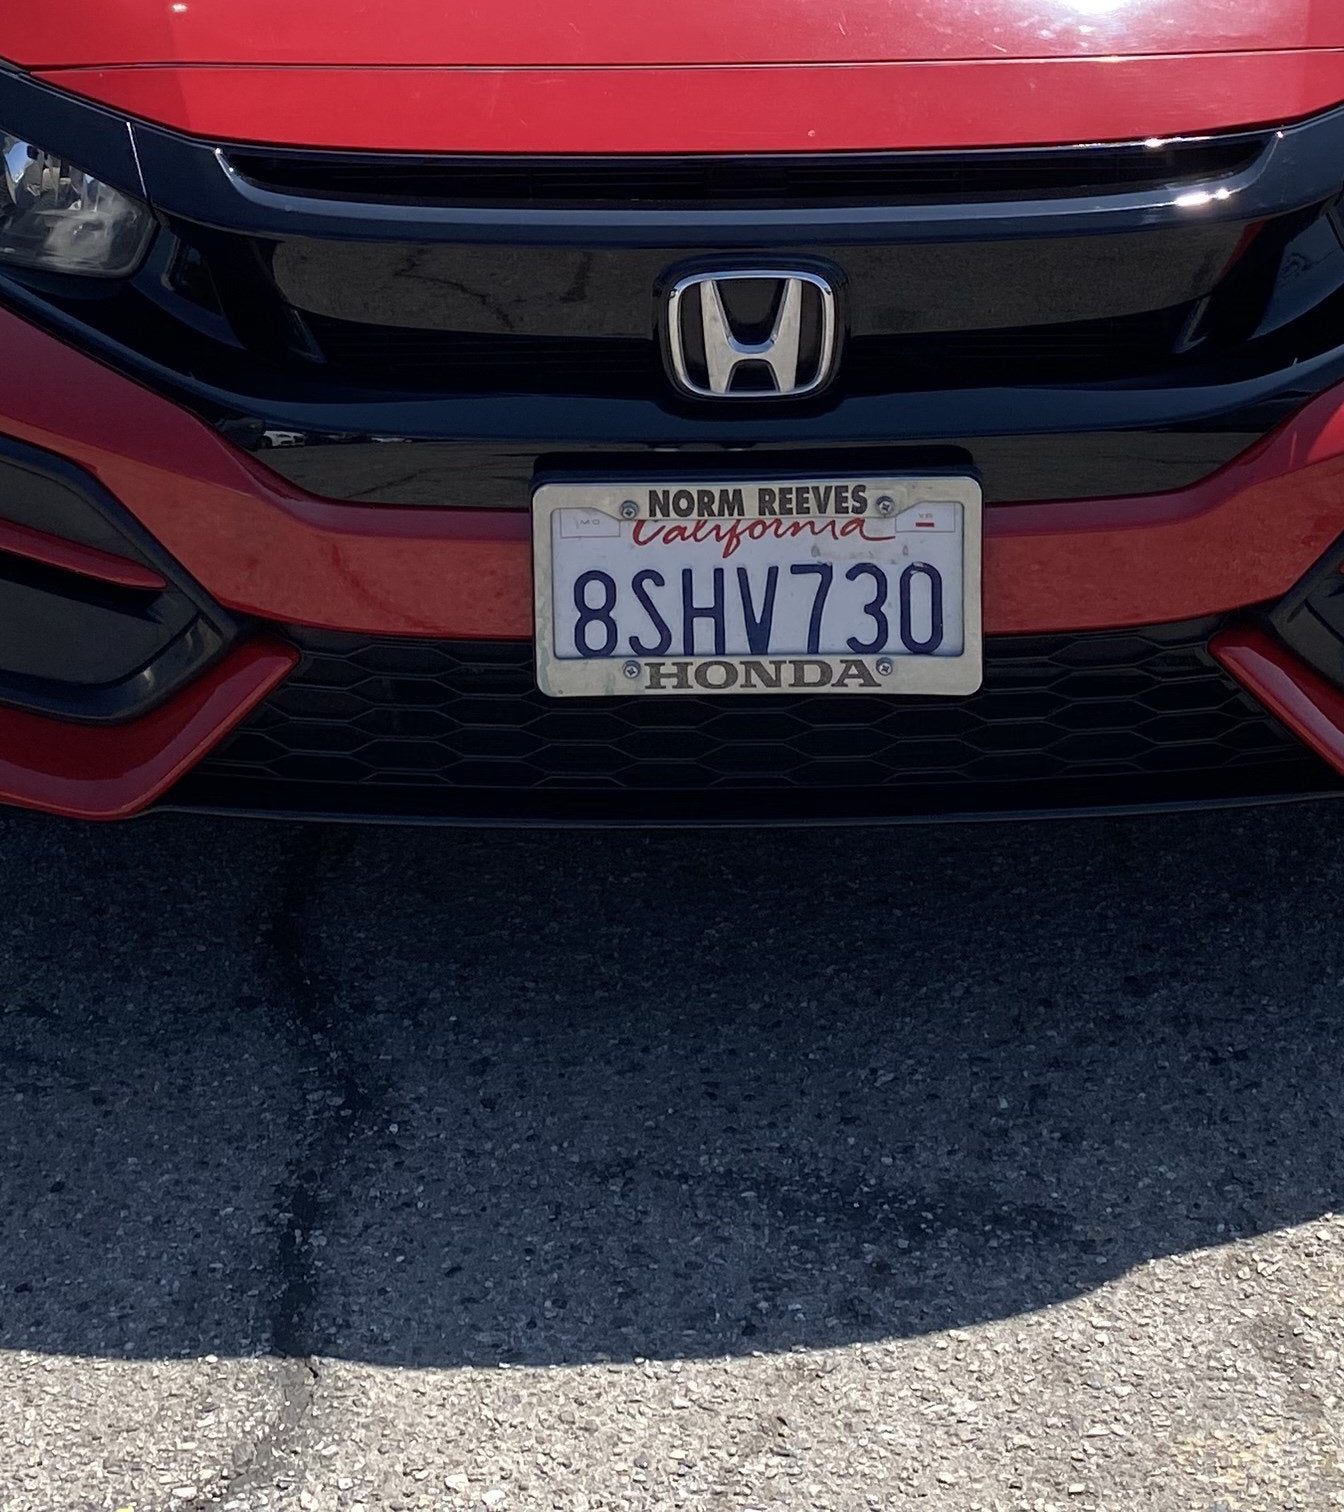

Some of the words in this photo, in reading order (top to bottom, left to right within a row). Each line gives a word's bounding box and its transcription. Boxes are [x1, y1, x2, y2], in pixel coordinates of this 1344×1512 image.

[648, 484, 745, 518] NORM
[758, 484, 868, 516] REEVES
[633, 518, 896, 558] California
[573, 561, 944, 656] 8SHV730
[645, 658, 883, 690] HONDA
